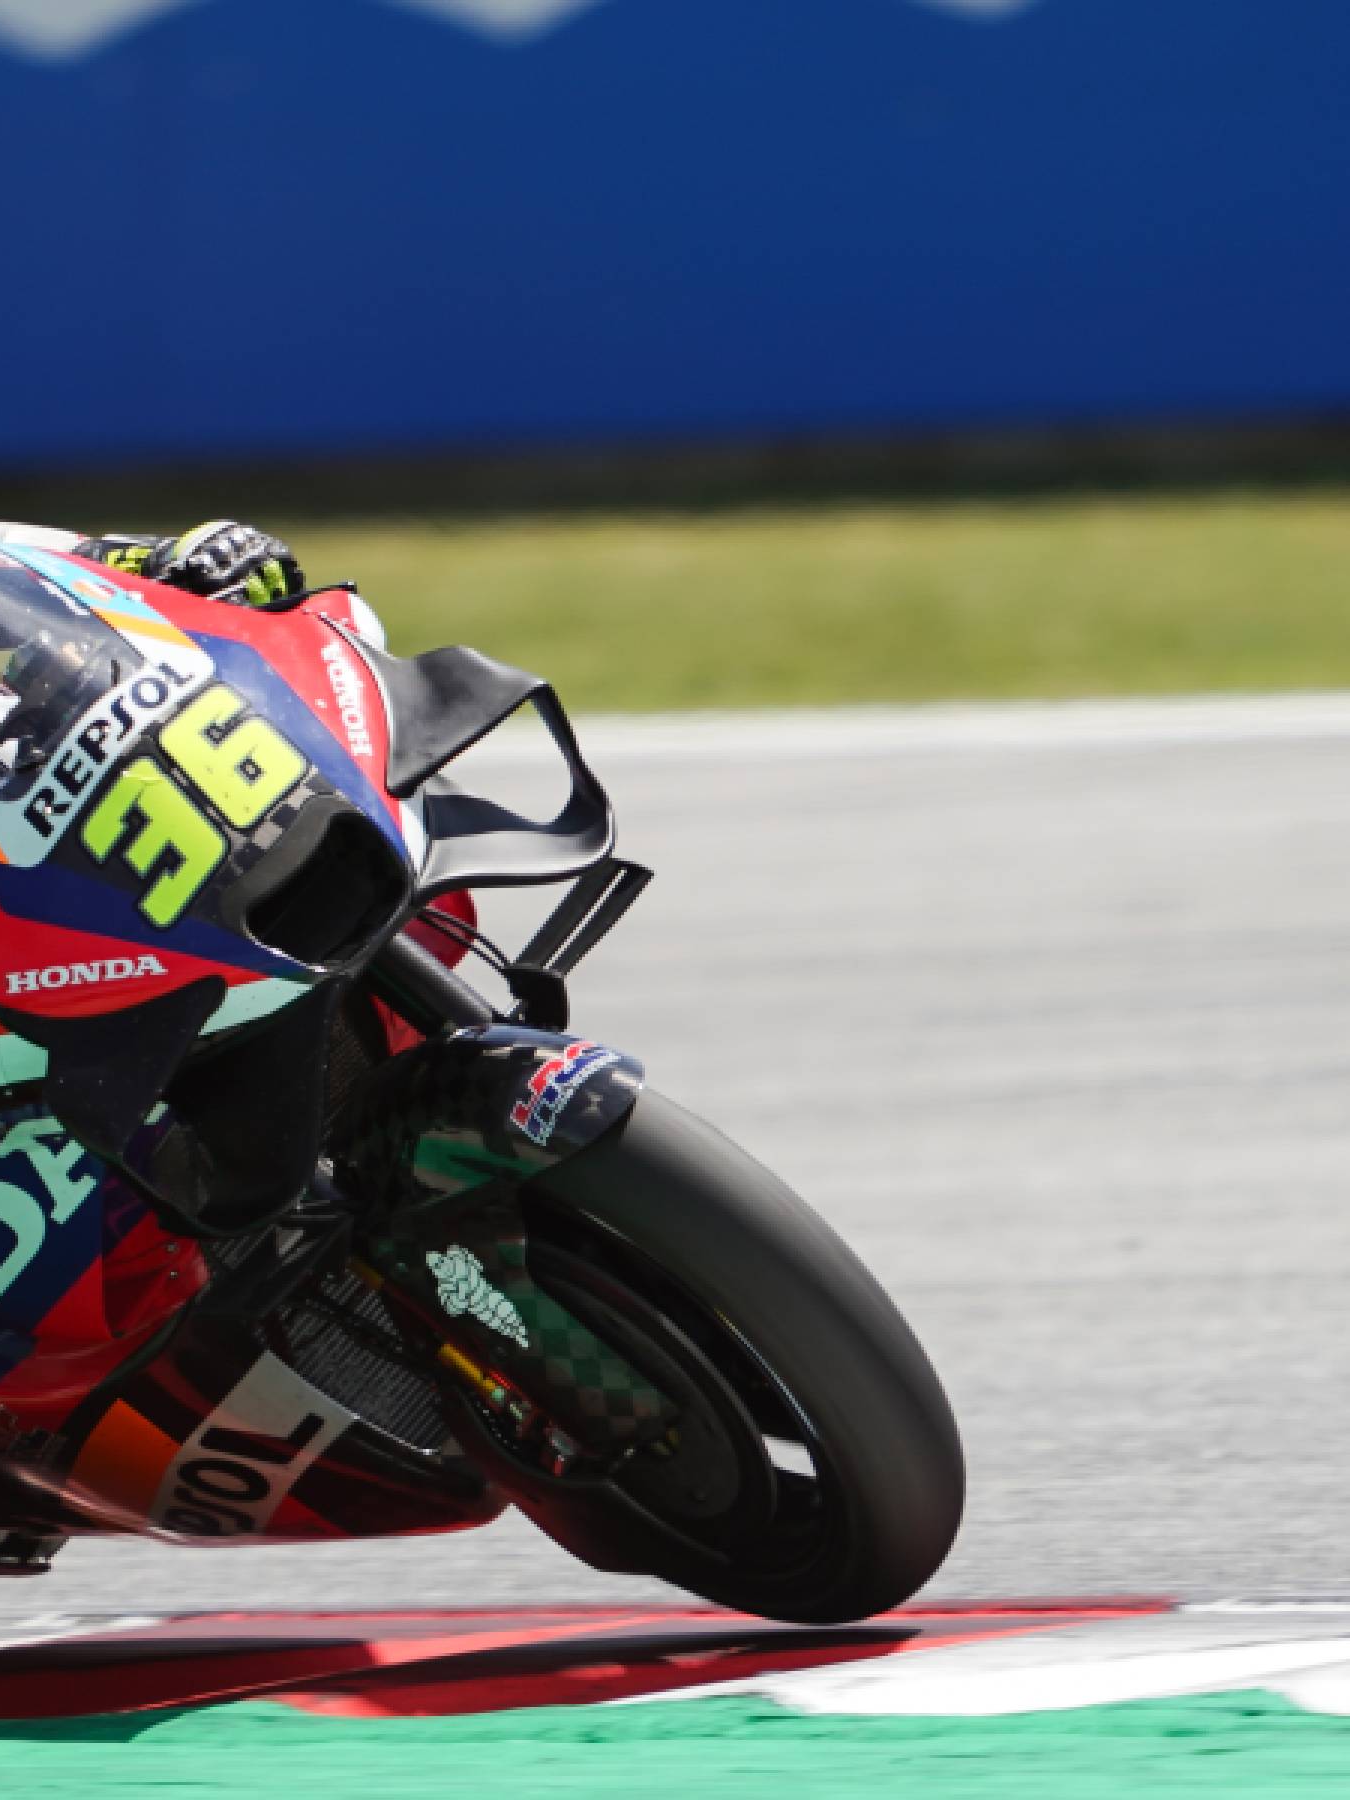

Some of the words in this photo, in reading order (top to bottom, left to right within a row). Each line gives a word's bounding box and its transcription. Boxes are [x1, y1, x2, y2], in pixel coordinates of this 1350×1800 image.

[23, 661, 194, 838] REPSOL
[79, 683, 310, 930] 36
[6, 955, 168, 994] HONDA
